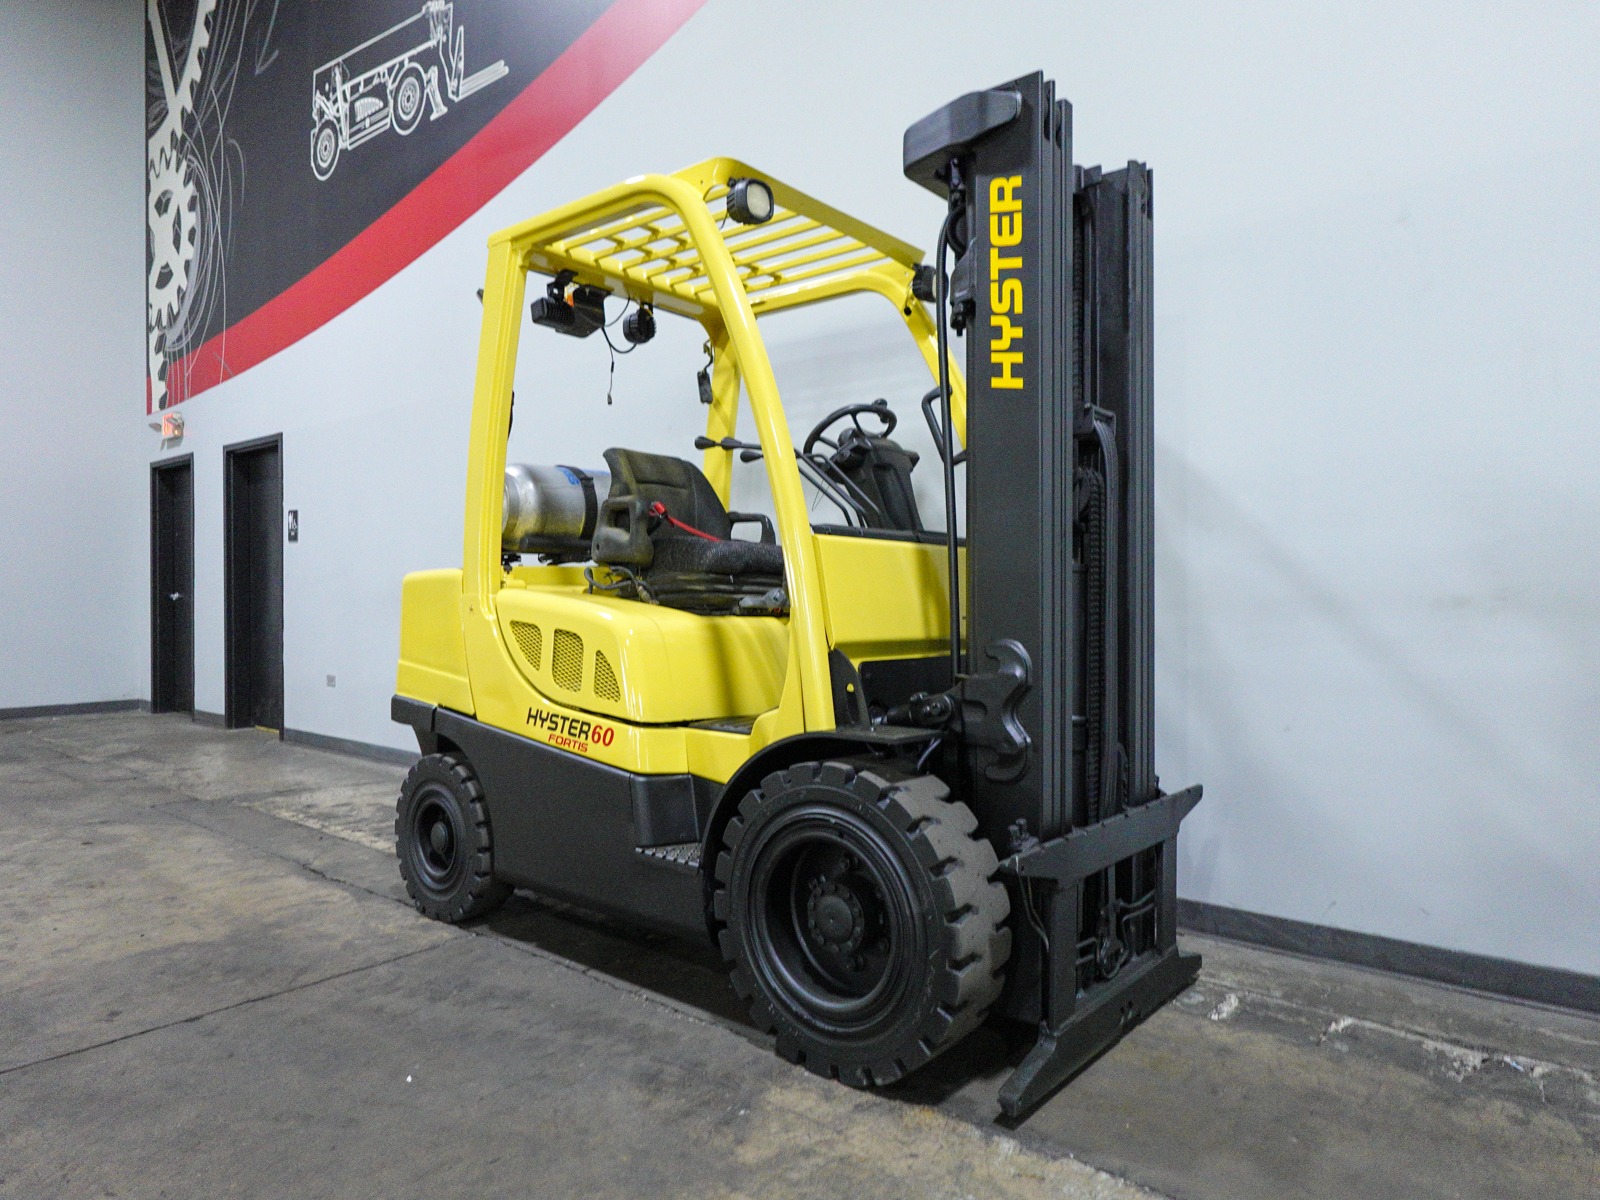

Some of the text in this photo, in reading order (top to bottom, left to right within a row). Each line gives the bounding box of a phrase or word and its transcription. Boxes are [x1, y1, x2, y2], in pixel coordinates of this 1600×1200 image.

[989, 175, 1024, 390] HYSTER
[526, 707, 615, 747] HYSTER 60
[548, 733, 588, 753] FORTIS
